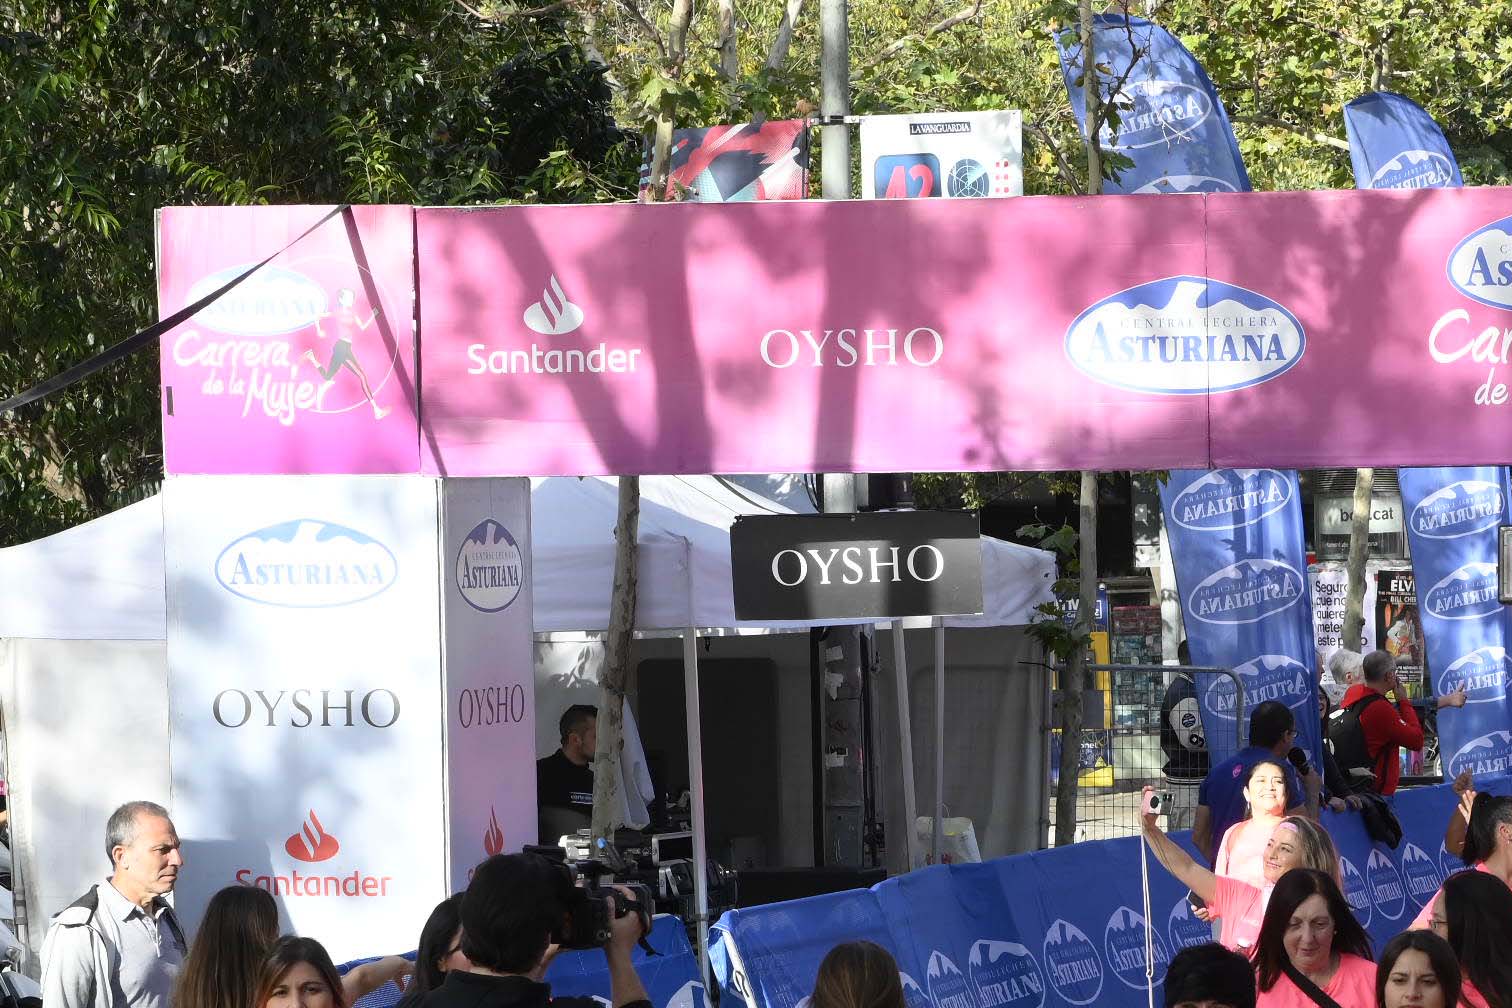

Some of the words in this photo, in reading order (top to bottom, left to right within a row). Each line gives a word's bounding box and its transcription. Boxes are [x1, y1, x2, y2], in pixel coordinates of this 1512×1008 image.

[467, 342, 641, 375] Santander
[760, 328, 944, 369] OYSHO
[1086, 321, 1287, 363] ASTURIANA
[1474, 368, 1509, 405] de
[229, 552, 385, 585] ASTURIANA
[460, 554, 519, 590] ASTURIANA
[772, 545, 944, 587] OYSHO
[1317, 609, 1346, 622] quiere
[212, 687, 400, 728] OYSHO
[458, 684, 525, 729] OYSHO
[235, 869, 392, 897] Santander
[1112, 940, 1165, 972] ASTURANA
